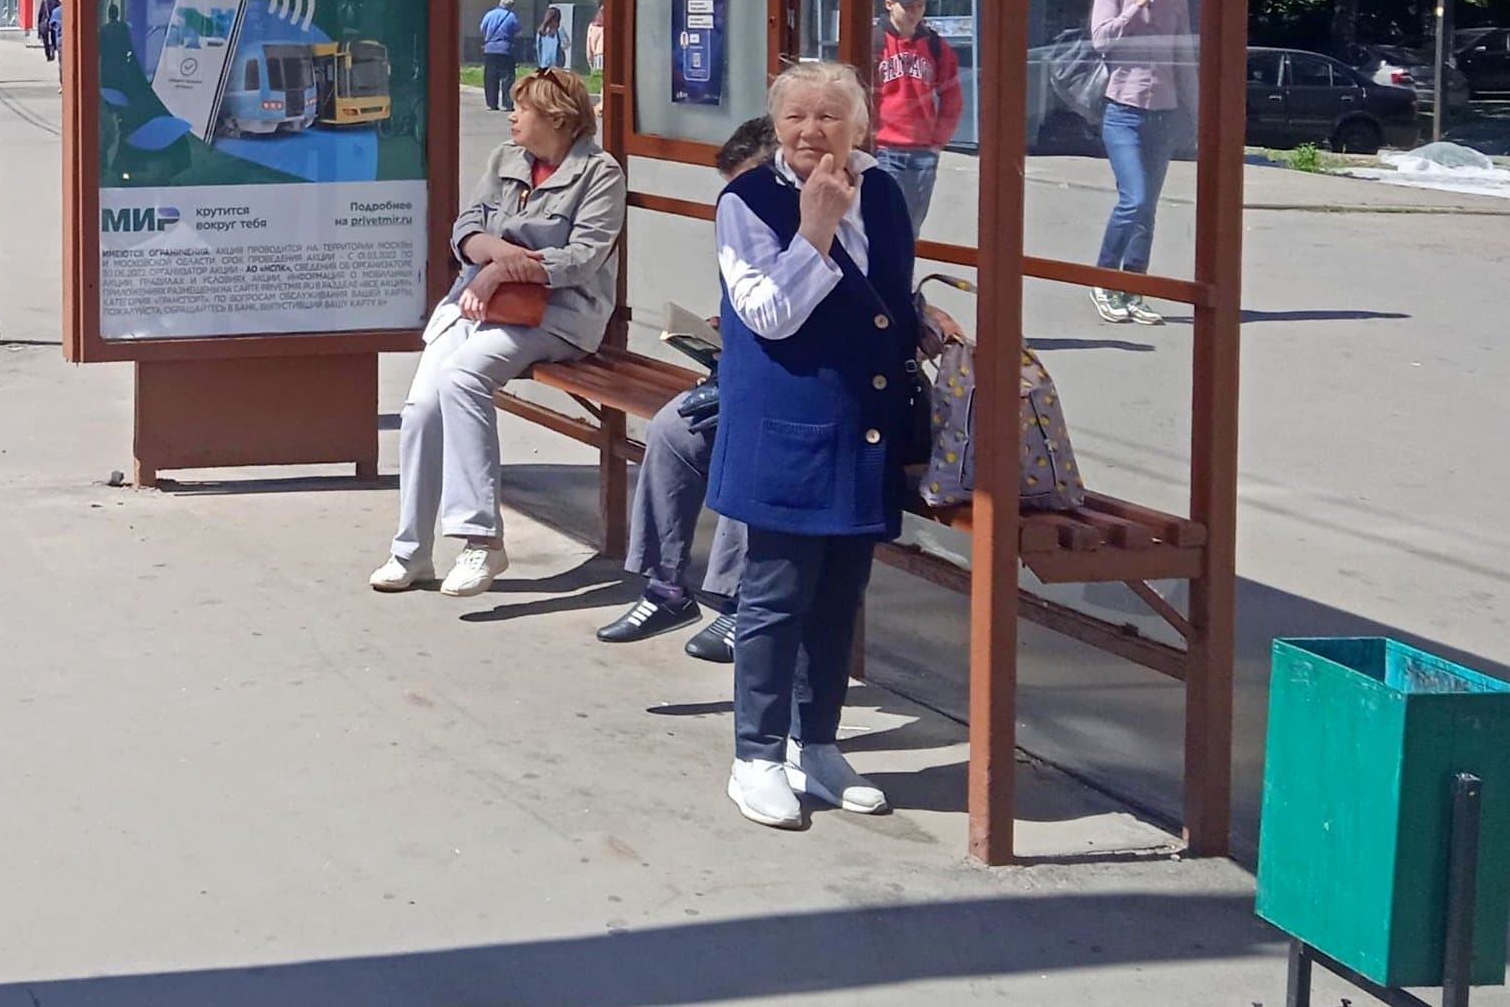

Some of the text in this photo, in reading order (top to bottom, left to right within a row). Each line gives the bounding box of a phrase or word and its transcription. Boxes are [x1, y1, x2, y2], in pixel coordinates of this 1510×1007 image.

[195, 205, 250, 219] крутится
[350, 200, 413, 214] Подробнее
[101, 207, 181, 233] МИР
[195, 218, 267, 233] вокруг тебя
[334, 213, 413, 227] на privetmir.ru
